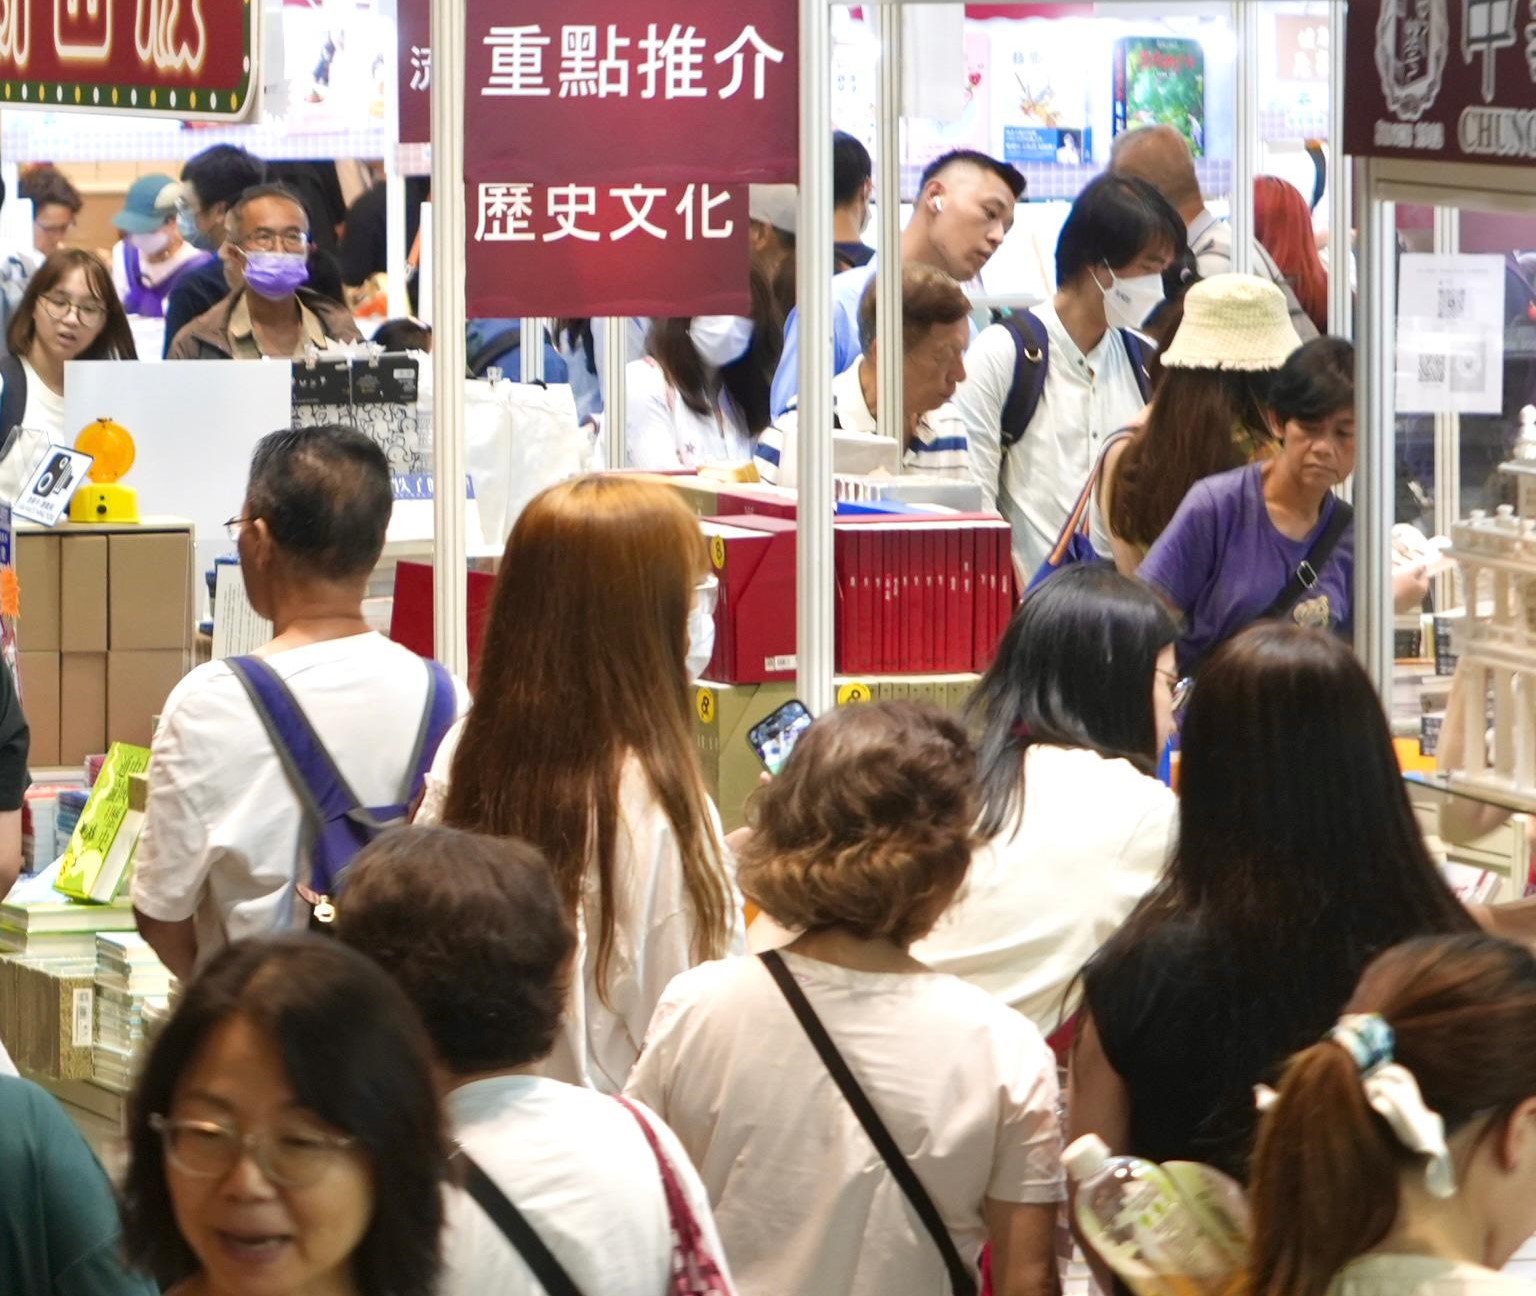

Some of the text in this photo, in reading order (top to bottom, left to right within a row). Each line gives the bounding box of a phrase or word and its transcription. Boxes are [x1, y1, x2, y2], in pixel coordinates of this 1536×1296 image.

[480, 22, 785, 100] 重點推介
[474, 182, 734, 242] 歷史文化
